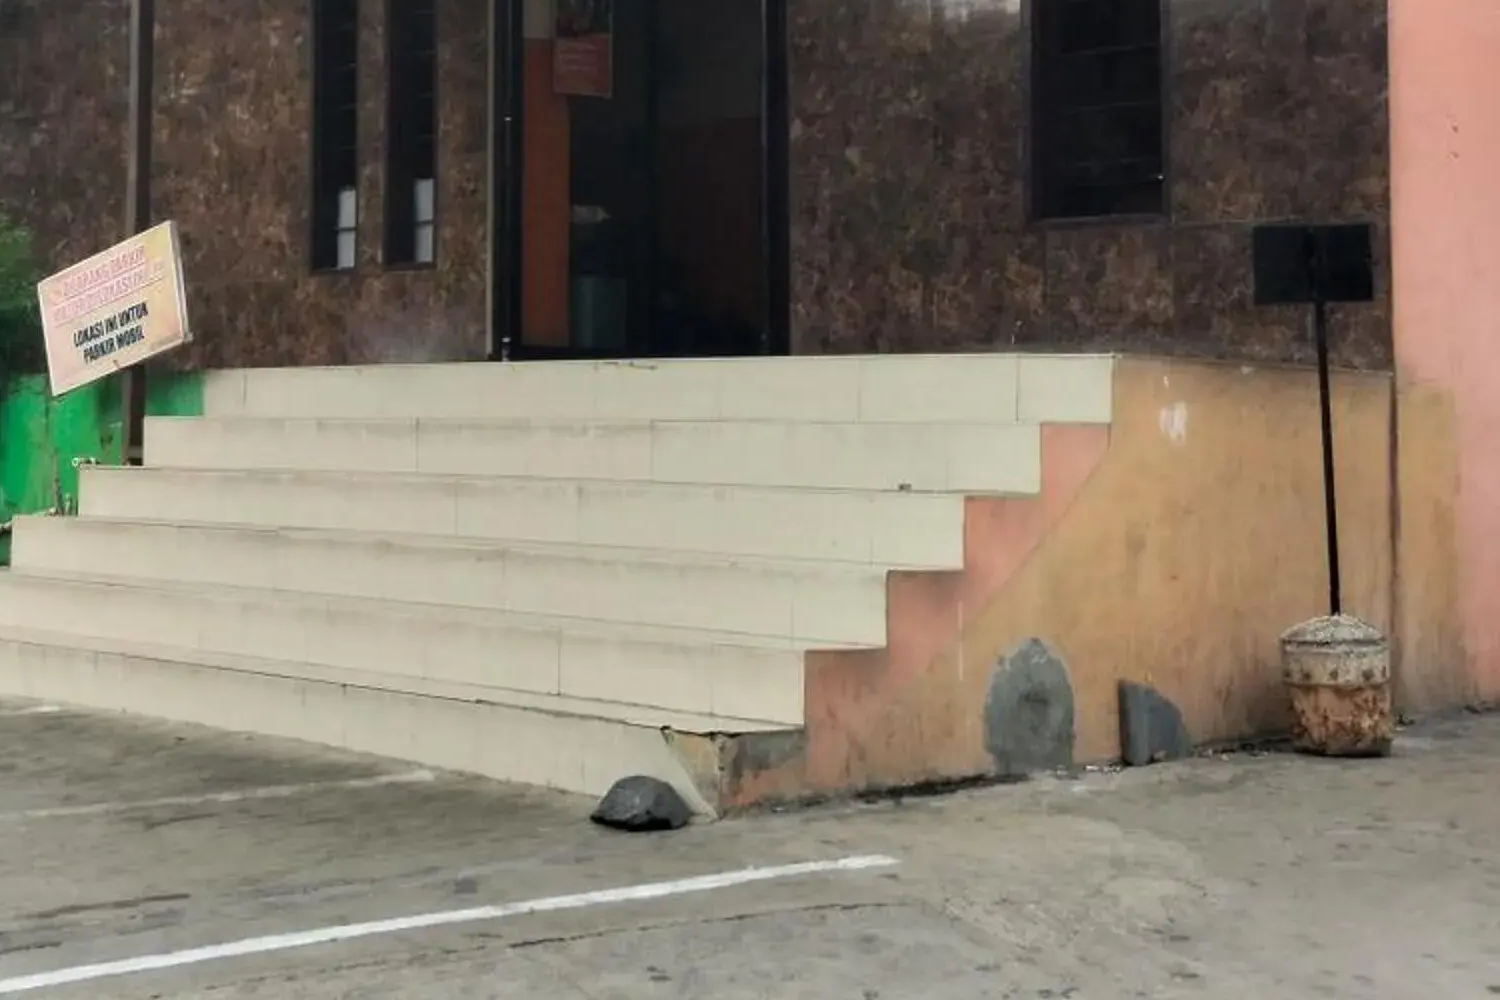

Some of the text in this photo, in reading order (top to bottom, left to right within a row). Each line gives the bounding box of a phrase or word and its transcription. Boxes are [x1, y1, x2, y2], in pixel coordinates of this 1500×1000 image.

[73, 320, 105, 348] LOKASI
[120, 302, 149, 331] UNTUK
[83, 325, 145, 364] PARKIR MOBIL
